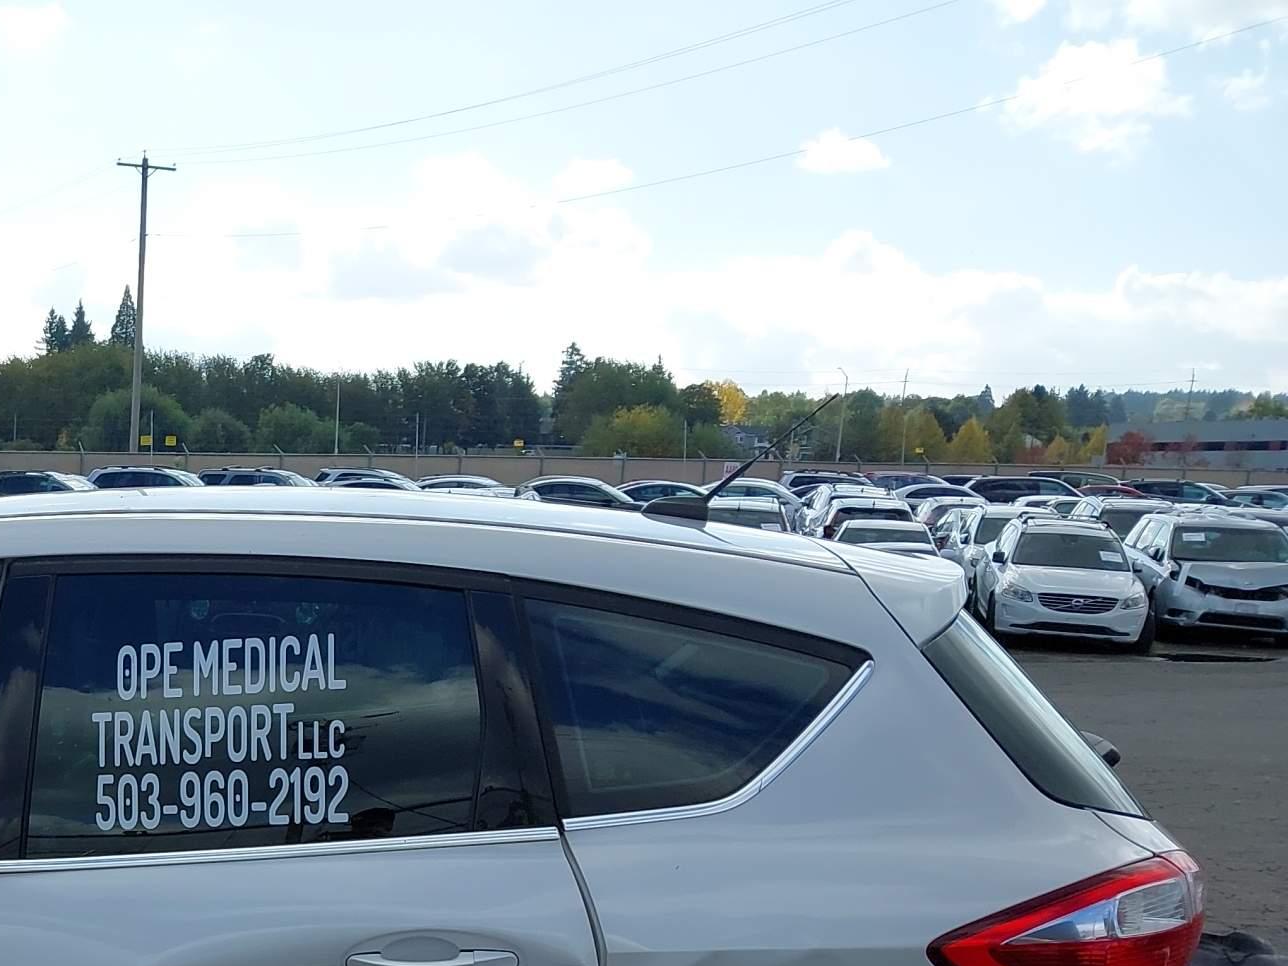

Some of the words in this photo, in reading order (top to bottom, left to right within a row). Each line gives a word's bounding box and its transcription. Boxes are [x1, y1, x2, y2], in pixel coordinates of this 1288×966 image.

[117, 642, 183, 700] OPE
[193, 633, 347, 697] MEDICAL
[92, 703, 294, 768] TRANSPORT
[298, 719, 345, 760] LLC
[95, 765, 349, 830] 503-960-2192
